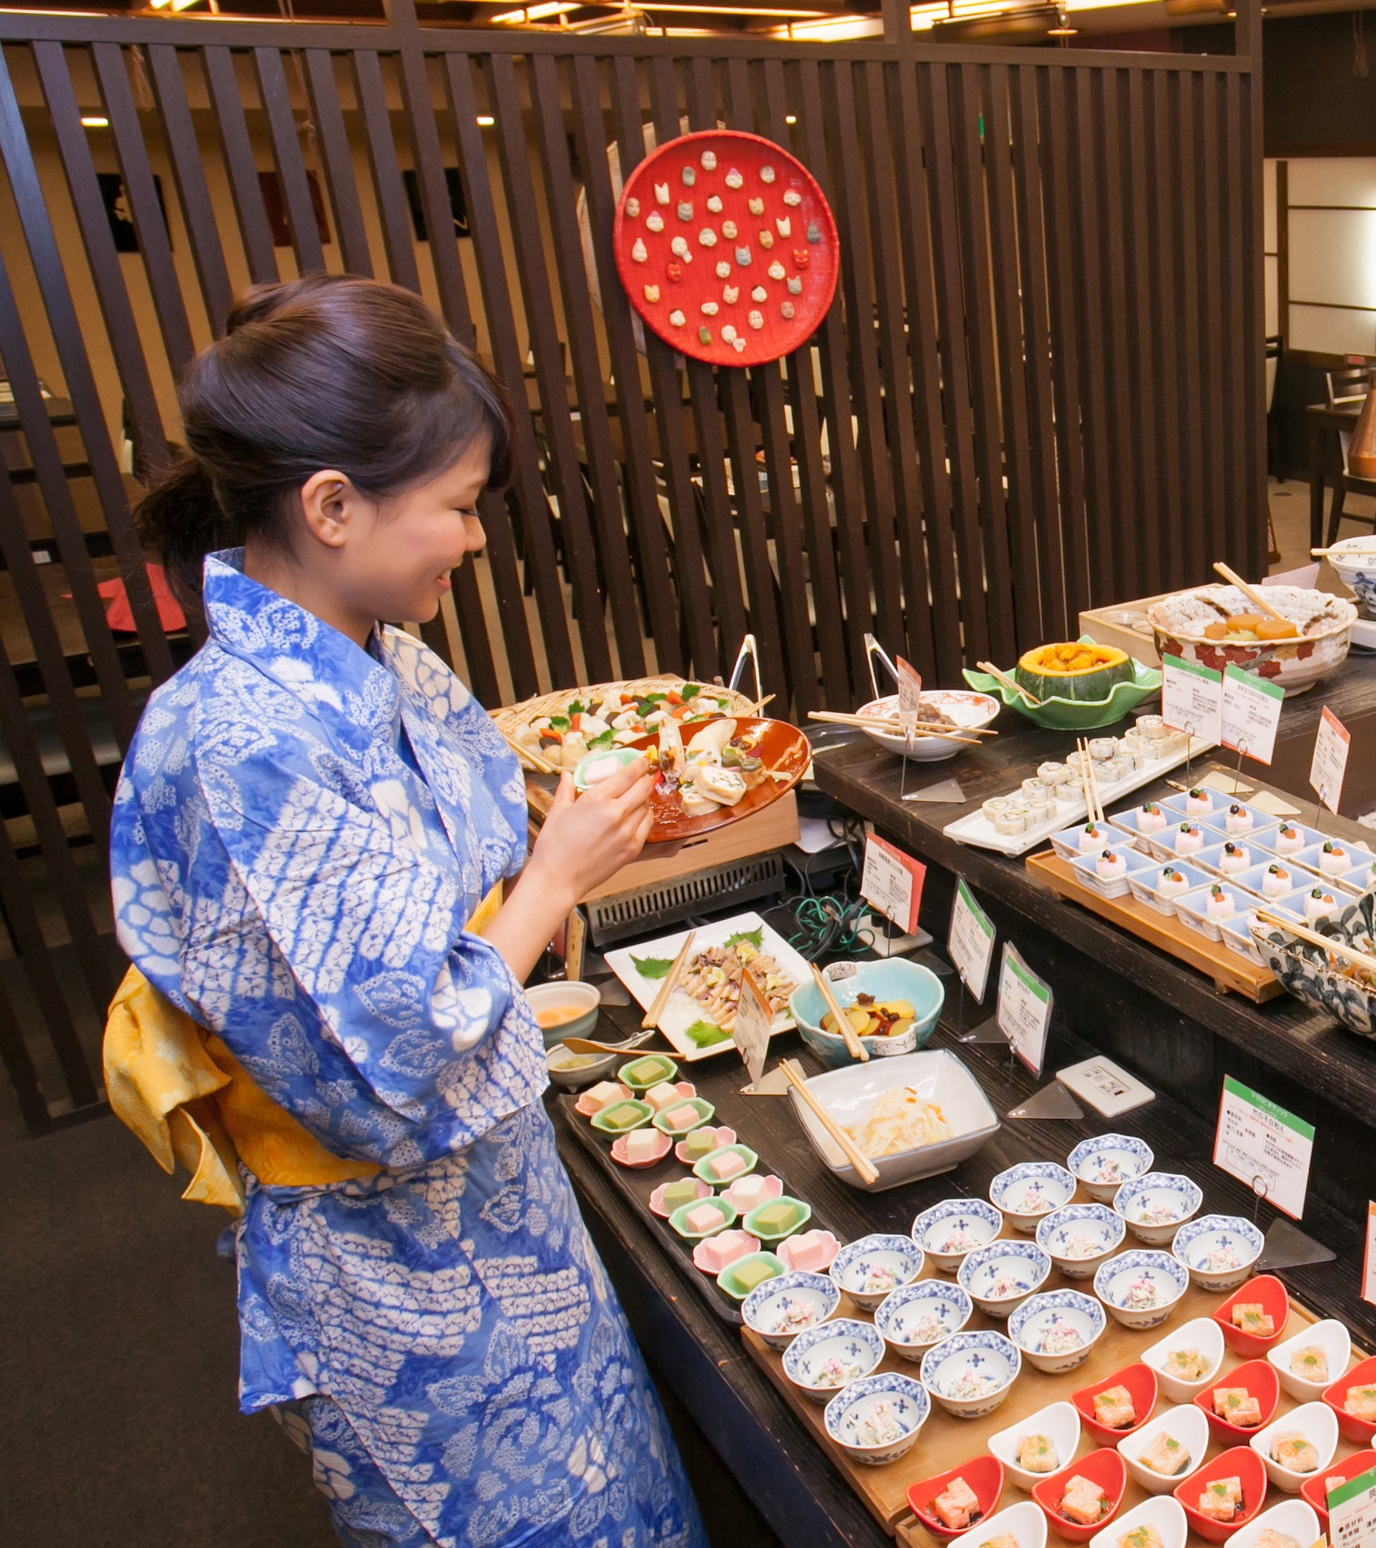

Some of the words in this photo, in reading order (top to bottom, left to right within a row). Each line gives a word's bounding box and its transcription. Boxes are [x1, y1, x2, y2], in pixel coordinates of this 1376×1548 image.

[1252, 1107, 1285, 1134] 竹の子白和え
